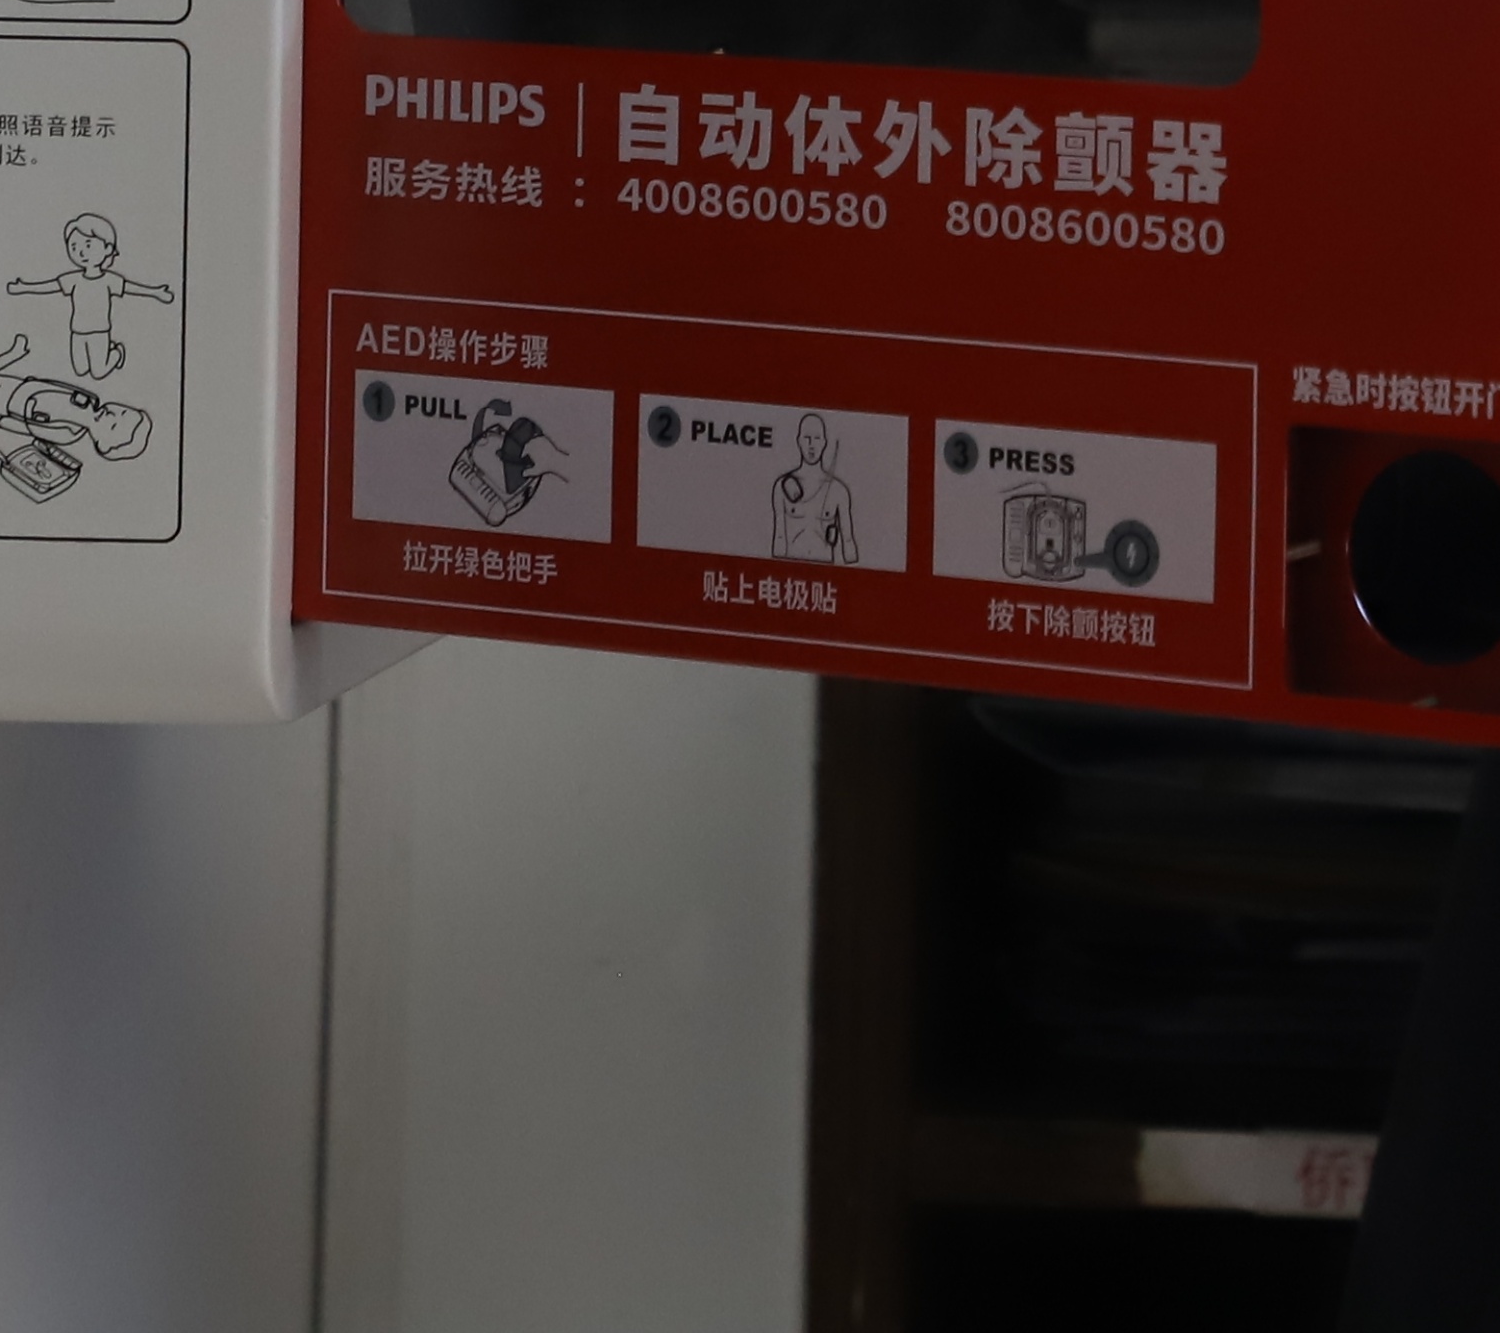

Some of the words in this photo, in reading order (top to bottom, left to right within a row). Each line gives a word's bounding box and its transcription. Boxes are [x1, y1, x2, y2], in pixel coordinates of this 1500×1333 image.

[366, 75, 545, 126] PHILIPS
[616, 84, 1228, 204] 自动体外除颤器
[618, 178, 886, 229] 4008600580
[946, 201, 1224, 255] 8008600580
[356, 323, 548, 369] AED操作步骤
[405, 393, 468, 422] PULL
[690, 419, 774, 449] PLACE
[989, 448, 1076, 476] PRESS
[404, 540, 557, 584] 拉开绿色把手
[703, 571, 837, 614] 贴上电极贴
[988, 599, 1155, 646] 按下除颤按钮
